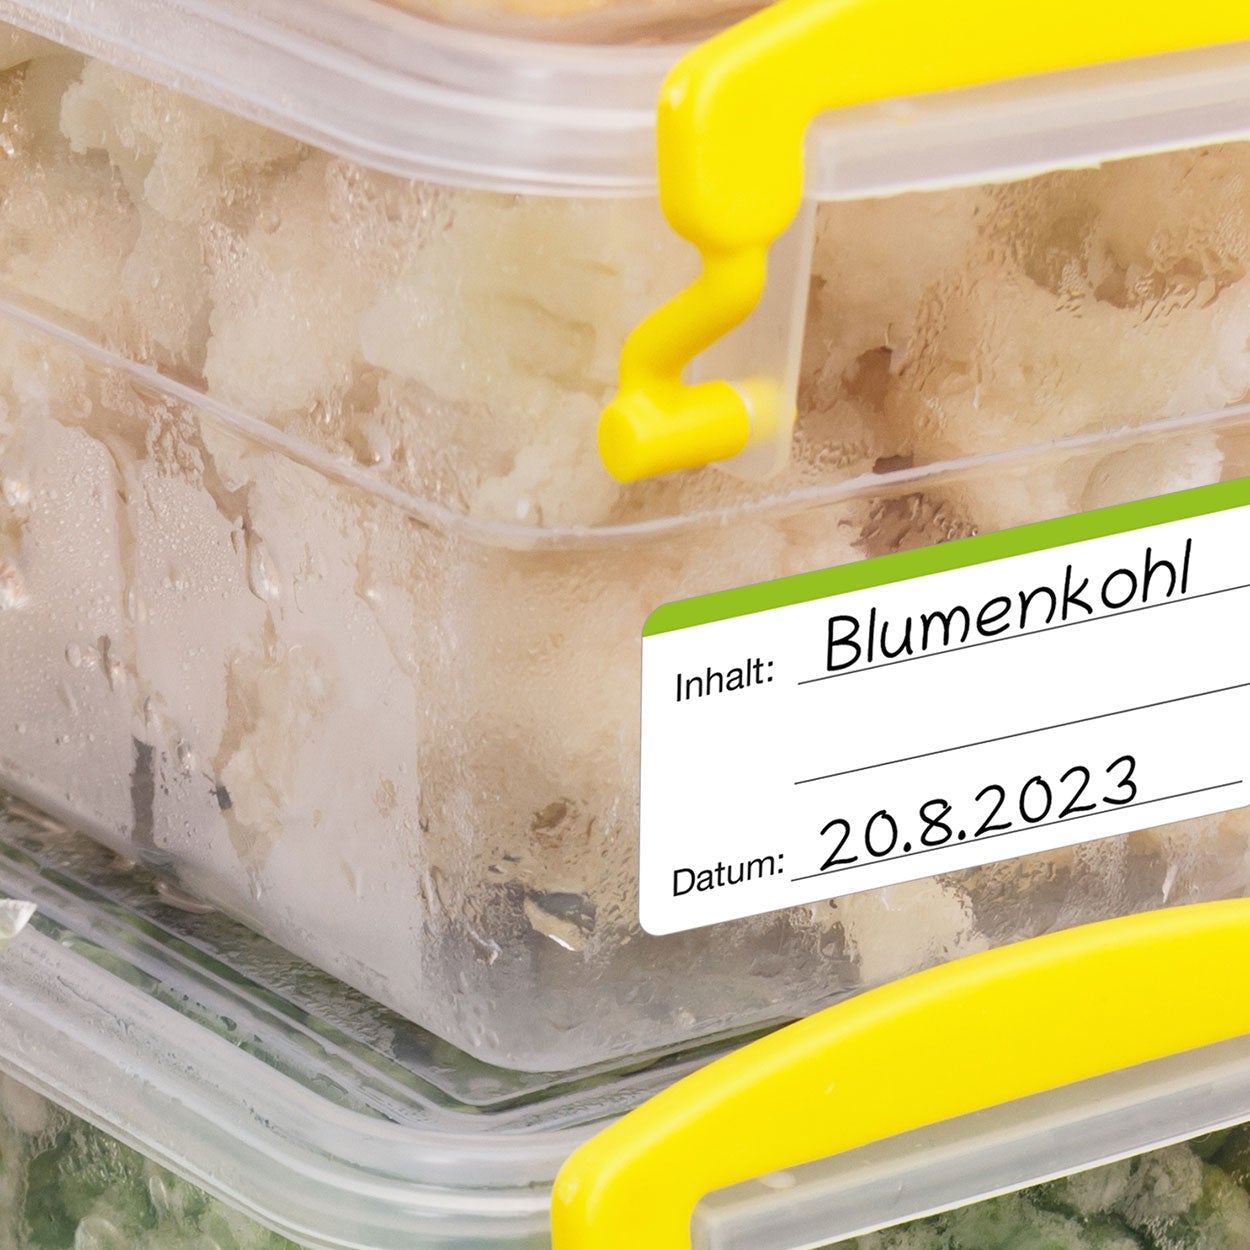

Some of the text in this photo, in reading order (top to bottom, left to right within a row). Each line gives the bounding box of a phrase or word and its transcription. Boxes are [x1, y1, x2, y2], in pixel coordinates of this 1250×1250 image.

[675, 538, 1193, 702] Inhalt: Blumenkohl
[672, 754, 1138, 896] Datum: 20.8.2023
